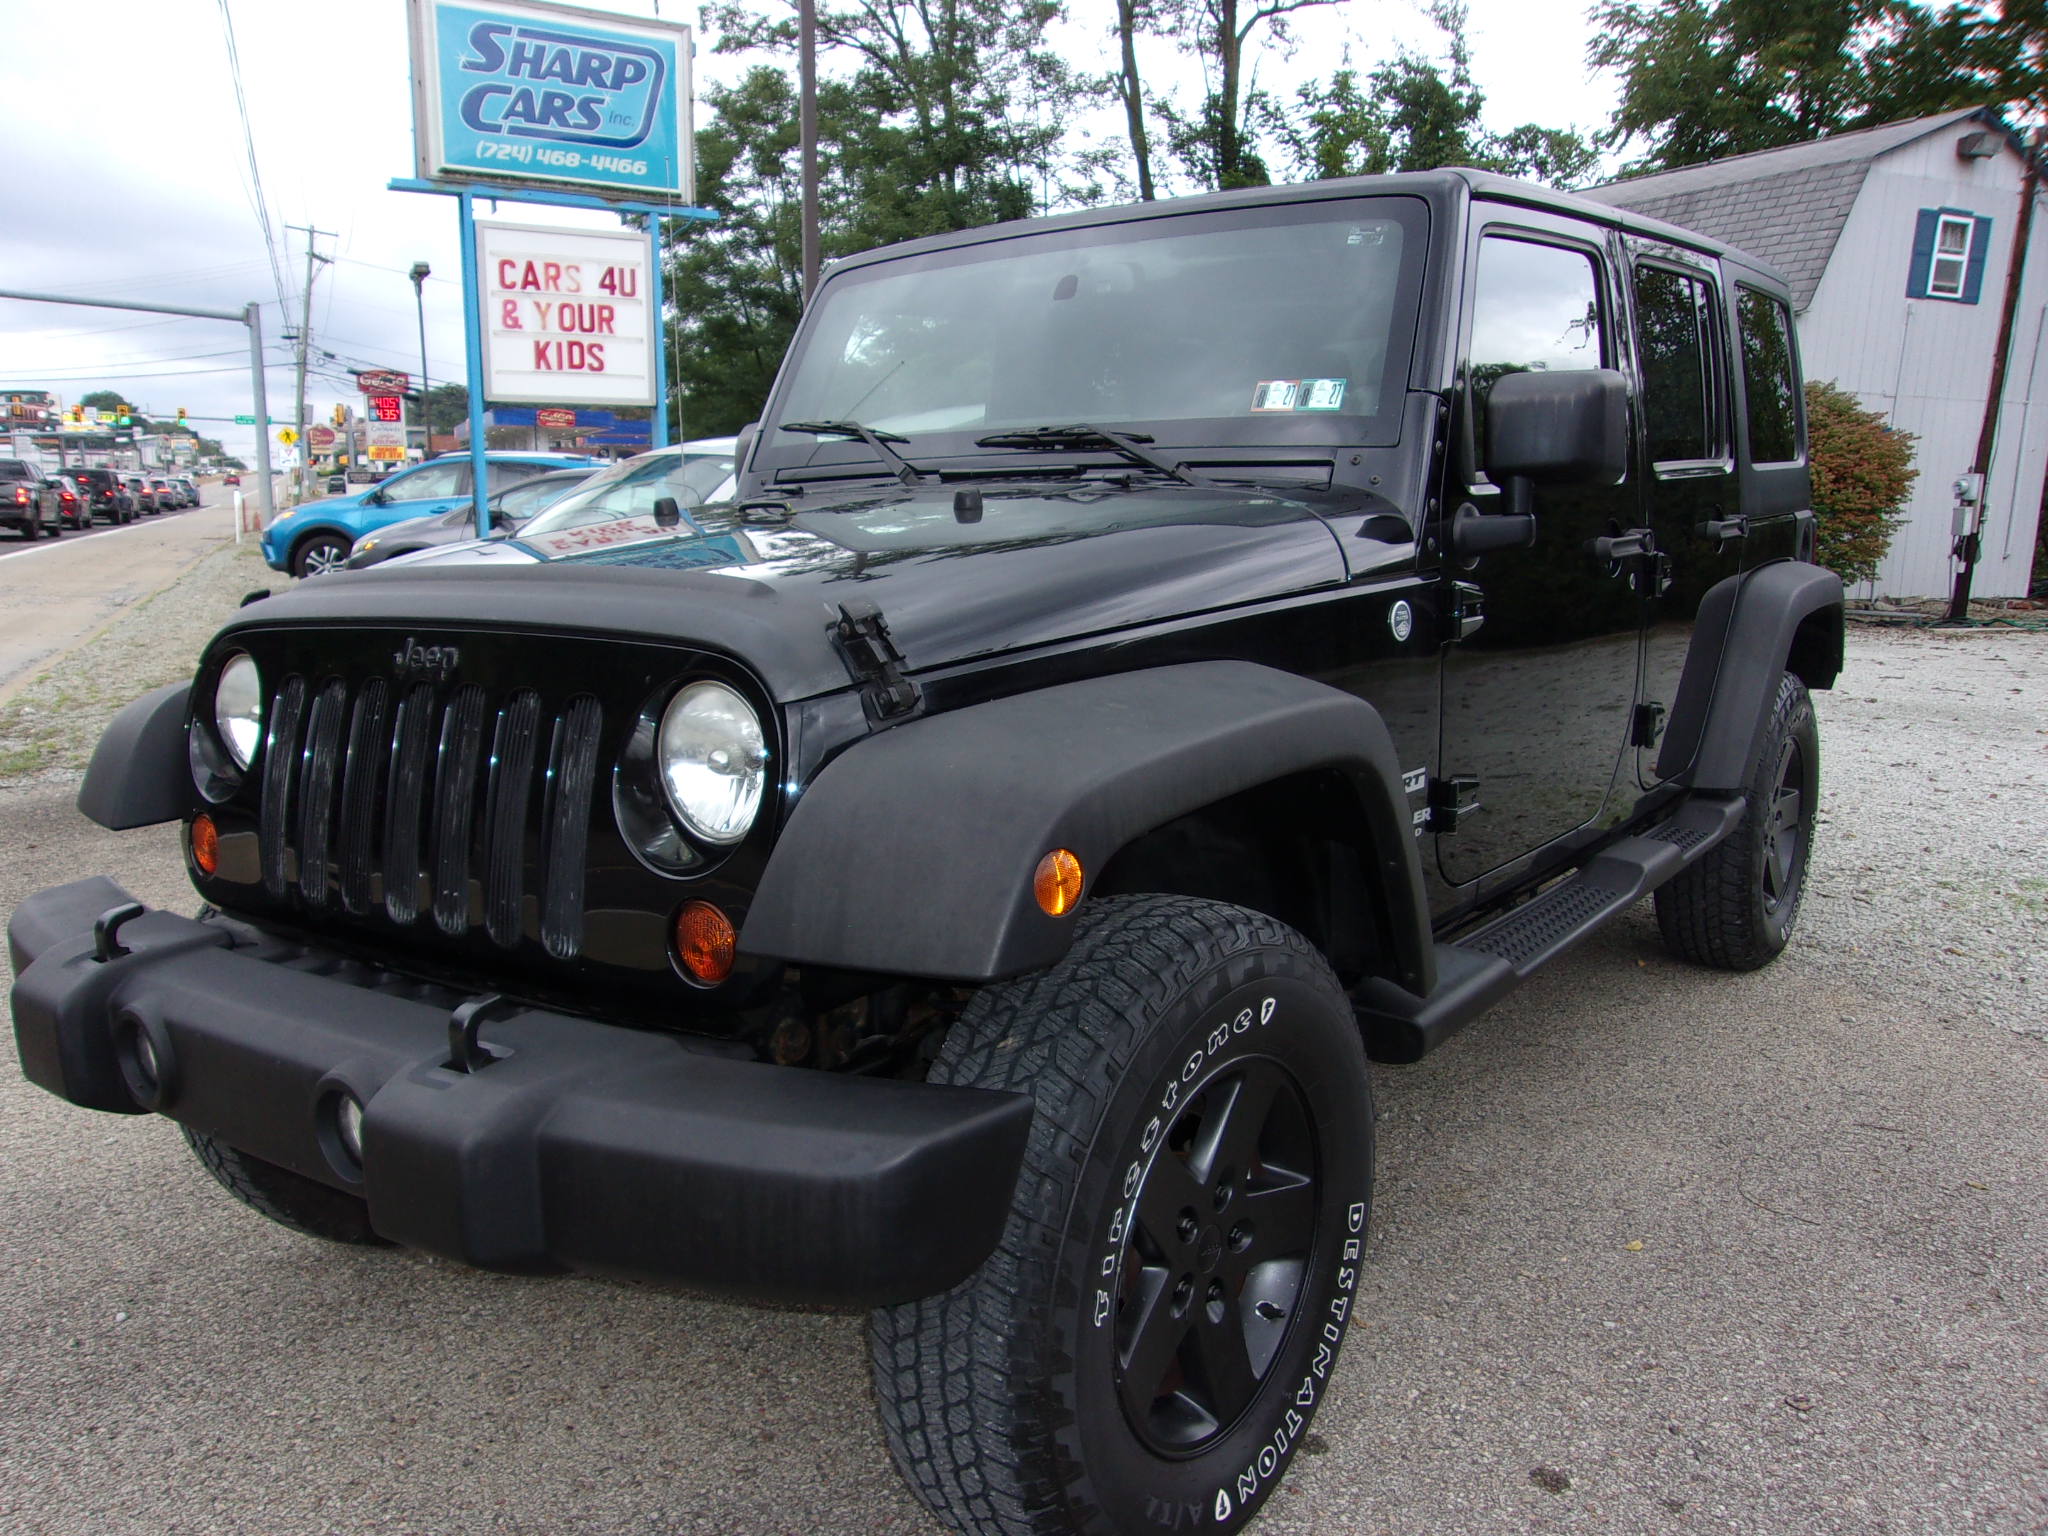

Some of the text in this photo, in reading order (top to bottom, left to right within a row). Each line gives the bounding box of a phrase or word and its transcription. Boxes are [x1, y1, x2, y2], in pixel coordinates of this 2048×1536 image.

[460, 21, 647, 91] SHARP
[460, 83, 635, 133] CARS Inc.
[475, 139, 647, 176] (724) 468-4466
[497, 259, 637, 297] CARS 4U
[501, 299, 615, 334] & YOUR
[533, 340, 605, 372] KIDS
[392, 637, 459, 681] Jeep
[1236, 1202, 1366, 1506] DESTINATION
